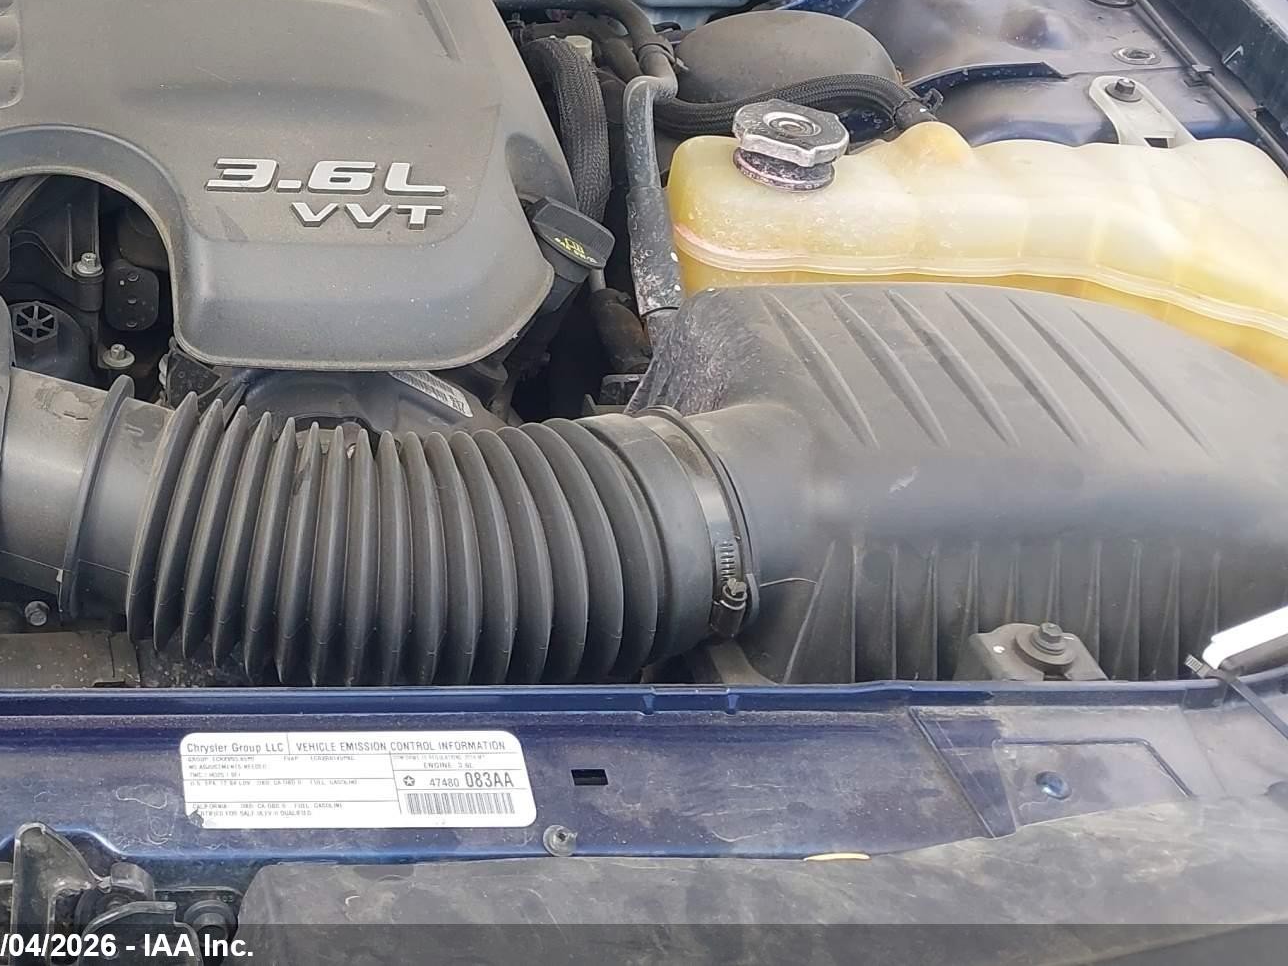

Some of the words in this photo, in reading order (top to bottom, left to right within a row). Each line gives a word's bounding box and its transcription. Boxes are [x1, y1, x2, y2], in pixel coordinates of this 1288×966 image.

[206, 158, 449, 197] 3.6L
[291, 202, 443, 231] VVT
[187, 742, 228, 754] Chrysler
[232, 742, 262, 754] Group
[266, 742, 284, 753] LLC
[296, 742, 337, 752] VEHICLE
[340, 742, 387, 751] EMISSION
[390, 741, 436, 751] CONTROL
[439, 740, 506, 751] INFORMATION
[429, 778, 460, 787] 47480
[465, 772, 514, 788] 083AA
